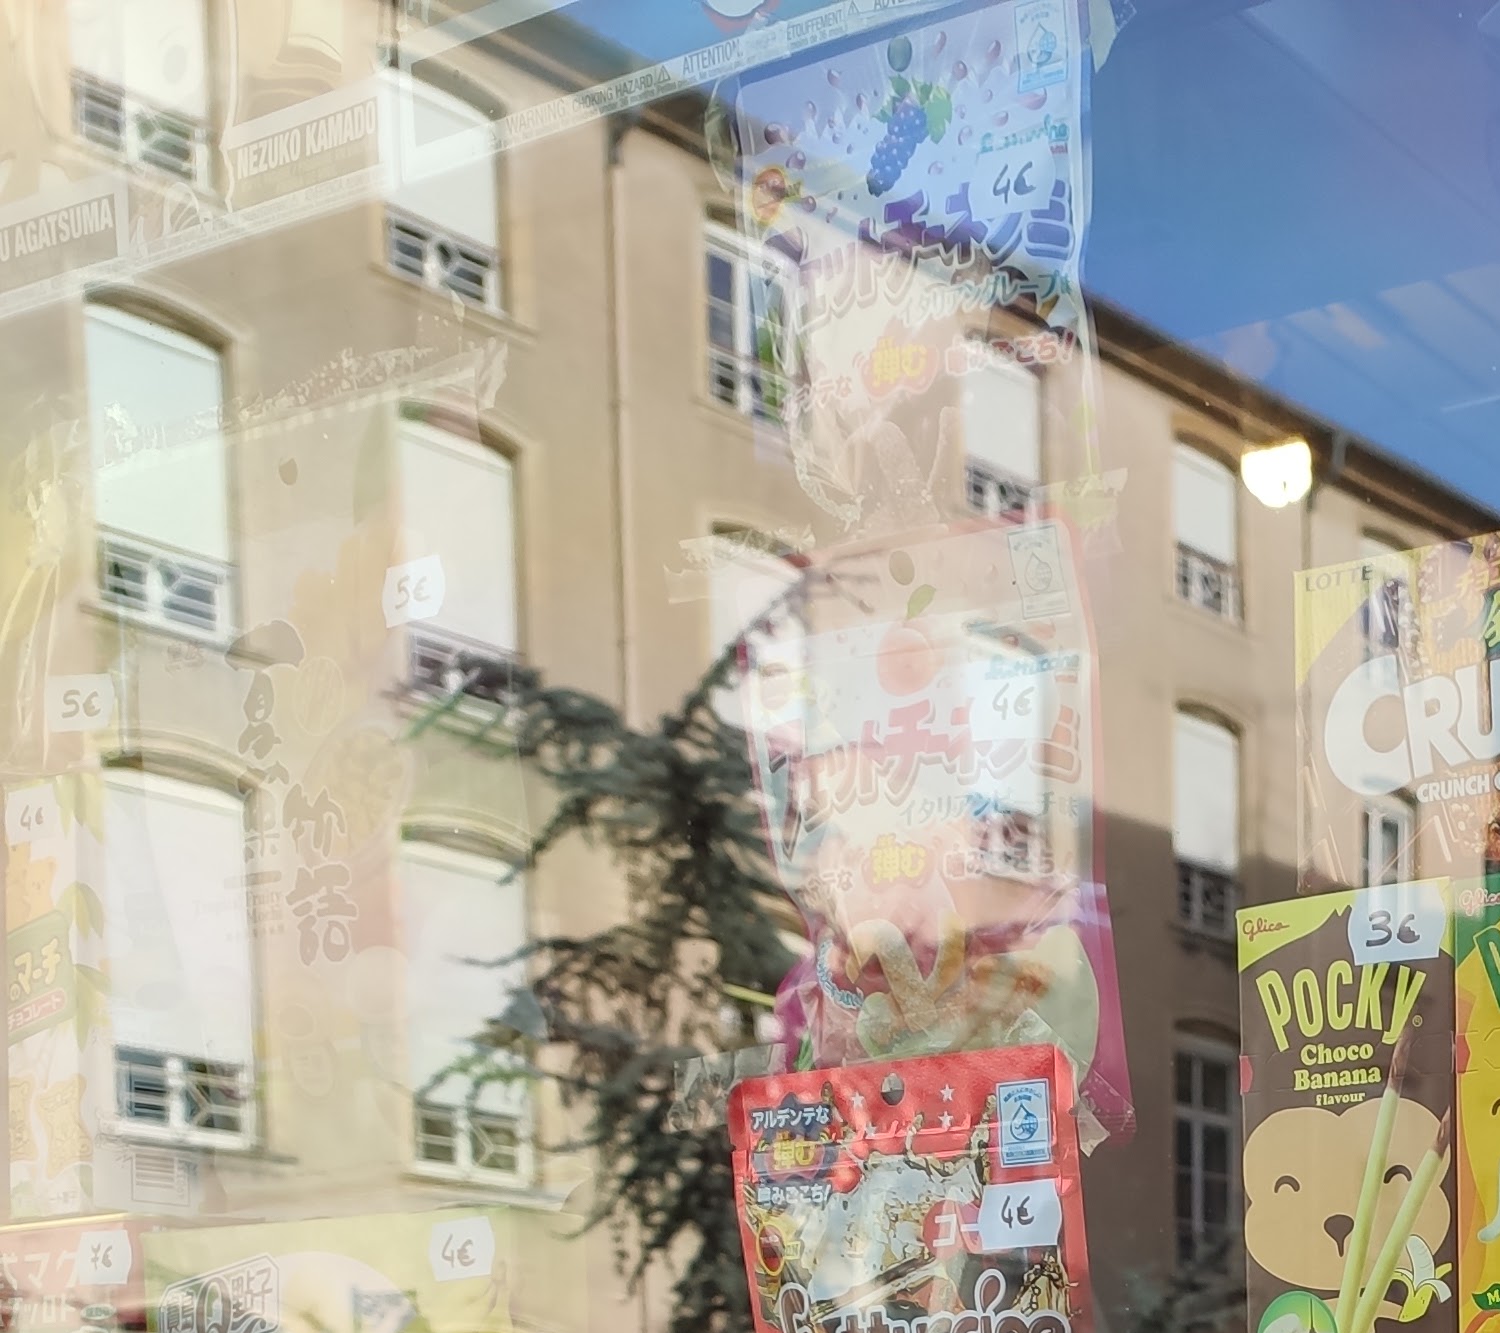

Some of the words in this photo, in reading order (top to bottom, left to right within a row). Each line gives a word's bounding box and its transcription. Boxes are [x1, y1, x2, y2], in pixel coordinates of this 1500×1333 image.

[236, 127, 301, 179] NEZUKO
[305, 100, 376, 156] KAMADO
[15, 198, 114, 259] AGATSUMA
[394, 574, 431, 611] 5€
[1304, 564, 1375, 593] LOTTE
[1416, 775, 1491, 803] CRUNCH
[1241, 919, 1290, 942] Glico
[1365, 912, 1421, 947] 3€
[1256, 959, 1426, 1052] POCKY
[1301, 1043, 1374, 1066] Choco
[1294, 1066, 1381, 1091] Banana
[1316, 1091, 1365, 1106] flavour
[1001, 1195, 1035, 1226] 4€
[442, 1234, 476, 1267] 4€
